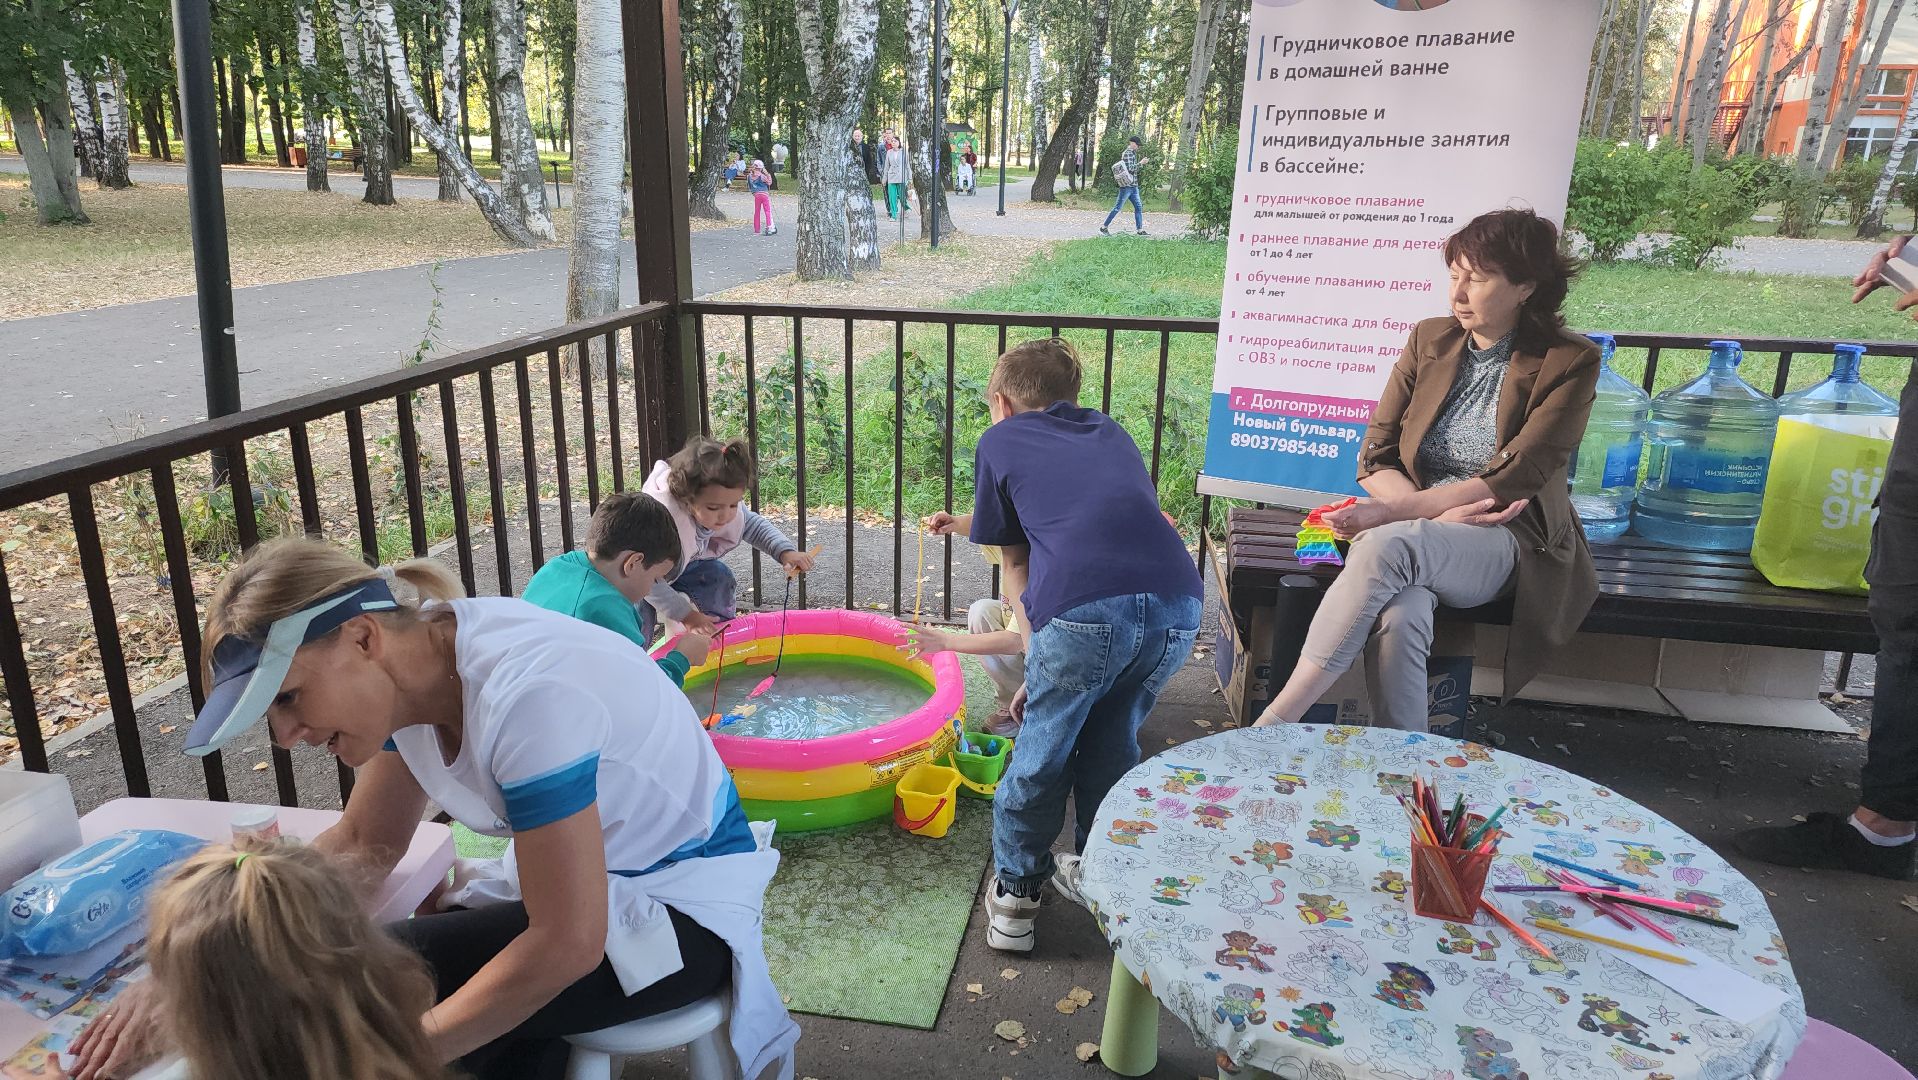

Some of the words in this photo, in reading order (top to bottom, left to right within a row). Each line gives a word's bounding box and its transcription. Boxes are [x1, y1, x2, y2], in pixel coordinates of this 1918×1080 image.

[1273, 35, 1409, 57] Грудничковое
[1415, 28, 1515, 47] плавание
[1270, 67, 1279, 79] в
[1284, 60, 1383, 81] домашней
[1390, 61, 1450, 76] ванне
[1265, 104, 1367, 125] Групповые
[1374, 107, 1386, 120] и
[1262, 133, 1425, 151] индивидуальные
[1431, 132, 1510, 147] занятия
[1260, 160, 1269, 173] в
[1274, 157, 1365, 174] бассейне:
[1256, 194, 1351, 207] грудничковое
[1355, 195, 1425, 207] плавание
[1254, 210, 1273, 219] для
[1276, 209, 1326, 221] малышей
[1329, 213, 1341, 221] от
[1343, 213, 1399, 224] рождения
[1402, 214, 1417, 223] до
[1420, 213, 1425, 222] 1
[1428, 214, 1453, 224] года
[1251, 232, 1299, 247] раннее
[1303, 234, 1369, 248] плавание
[1372, 237, 1399, 249] для
[1403, 237, 1446, 251] детей
[1263, 248, 1267, 257] 1
[1270, 250, 1283, 259] до
[1286, 249, 1293, 258] 4
[1295, 251, 1313, 259] лет
[1248, 271, 1311, 286] обучение
[1315, 276, 1385, 289] плаванию
[1390, 279, 1431, 292] детей
[1259, 287, 1265, 295] 4
[1268, 289, 1285, 297] лет
[1243, 311, 1348, 327] аквагимнастика
[1352, 319, 1377, 330] для
[1240, 335, 1373, 355] гидрореабилитация
[1378, 345, 1403, 356] для
[1249, 352, 1275, 365] ОВЗ
[1280, 356, 1287, 365] и
[1292, 357, 1331, 369] после
[1235, 396, 1246, 406] г.
[1250, 394, 1370, 419] Долгопрудный
[1234, 412, 1287, 431] Новый
[1290, 422, 1360, 442] бульвар,
[1231, 433, 1339, 458] 89037985488
